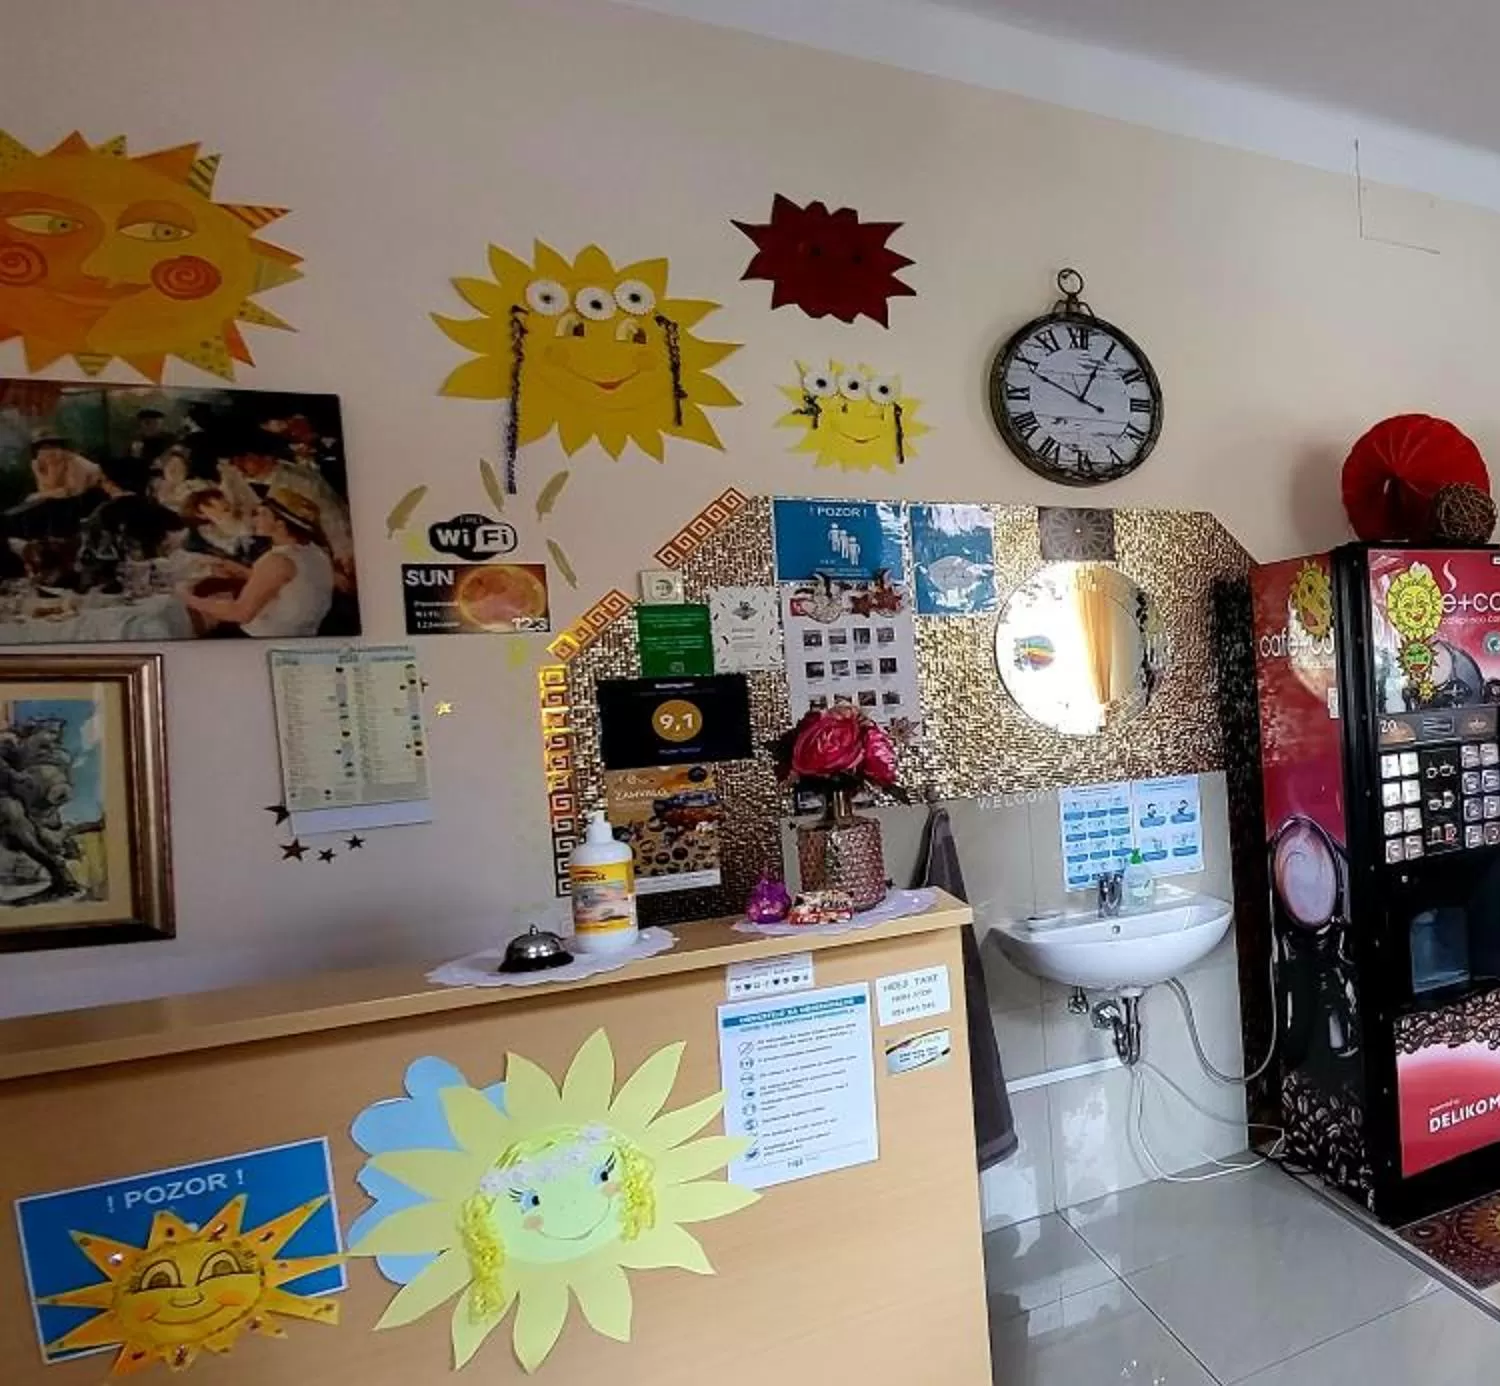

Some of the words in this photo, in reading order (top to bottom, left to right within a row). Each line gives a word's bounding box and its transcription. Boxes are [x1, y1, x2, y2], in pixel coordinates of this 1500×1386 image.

[817, 507, 861, 517] POZOR
[405, 569, 455, 586] SUN
[659, 712, 694, 732] 9,1
[124, 1173, 228, 1209] POZOR
